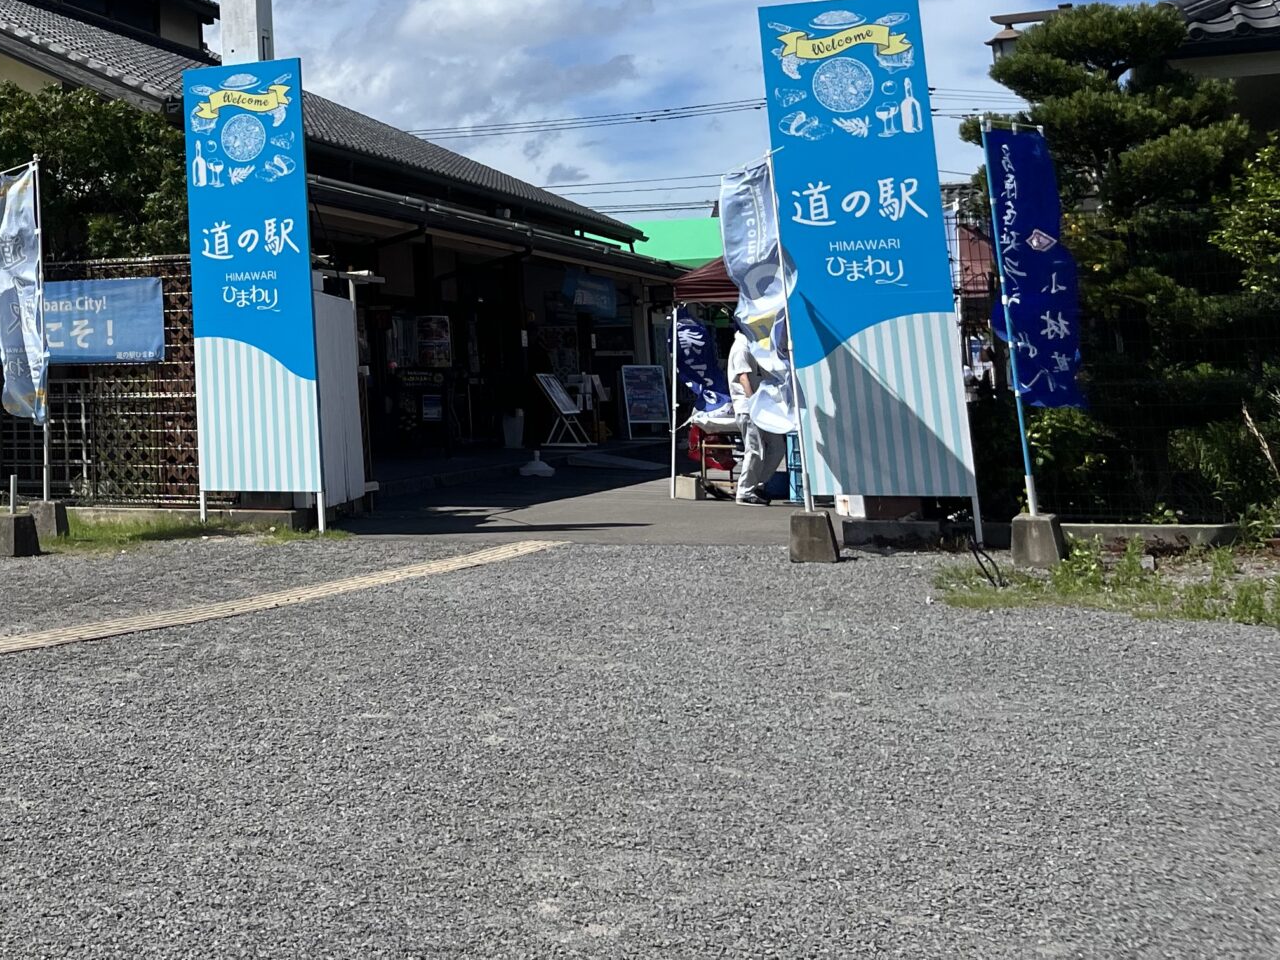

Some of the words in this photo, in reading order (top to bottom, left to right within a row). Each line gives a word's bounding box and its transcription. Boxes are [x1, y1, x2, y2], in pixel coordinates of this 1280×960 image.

[811, 29, 873, 56] Welcome
[223, 91, 270, 107] Welcome
[791, 178, 929, 227] 道の駅
[202, 218, 300, 260] 道の駅
[829, 238, 901, 253] HIMAWARI
[225, 271, 277, 282] HIMAWARI
[825, 255, 909, 287] ひまわり
[74, 296, 108, 315] City!
[222, 285, 281, 312] ひまわり
